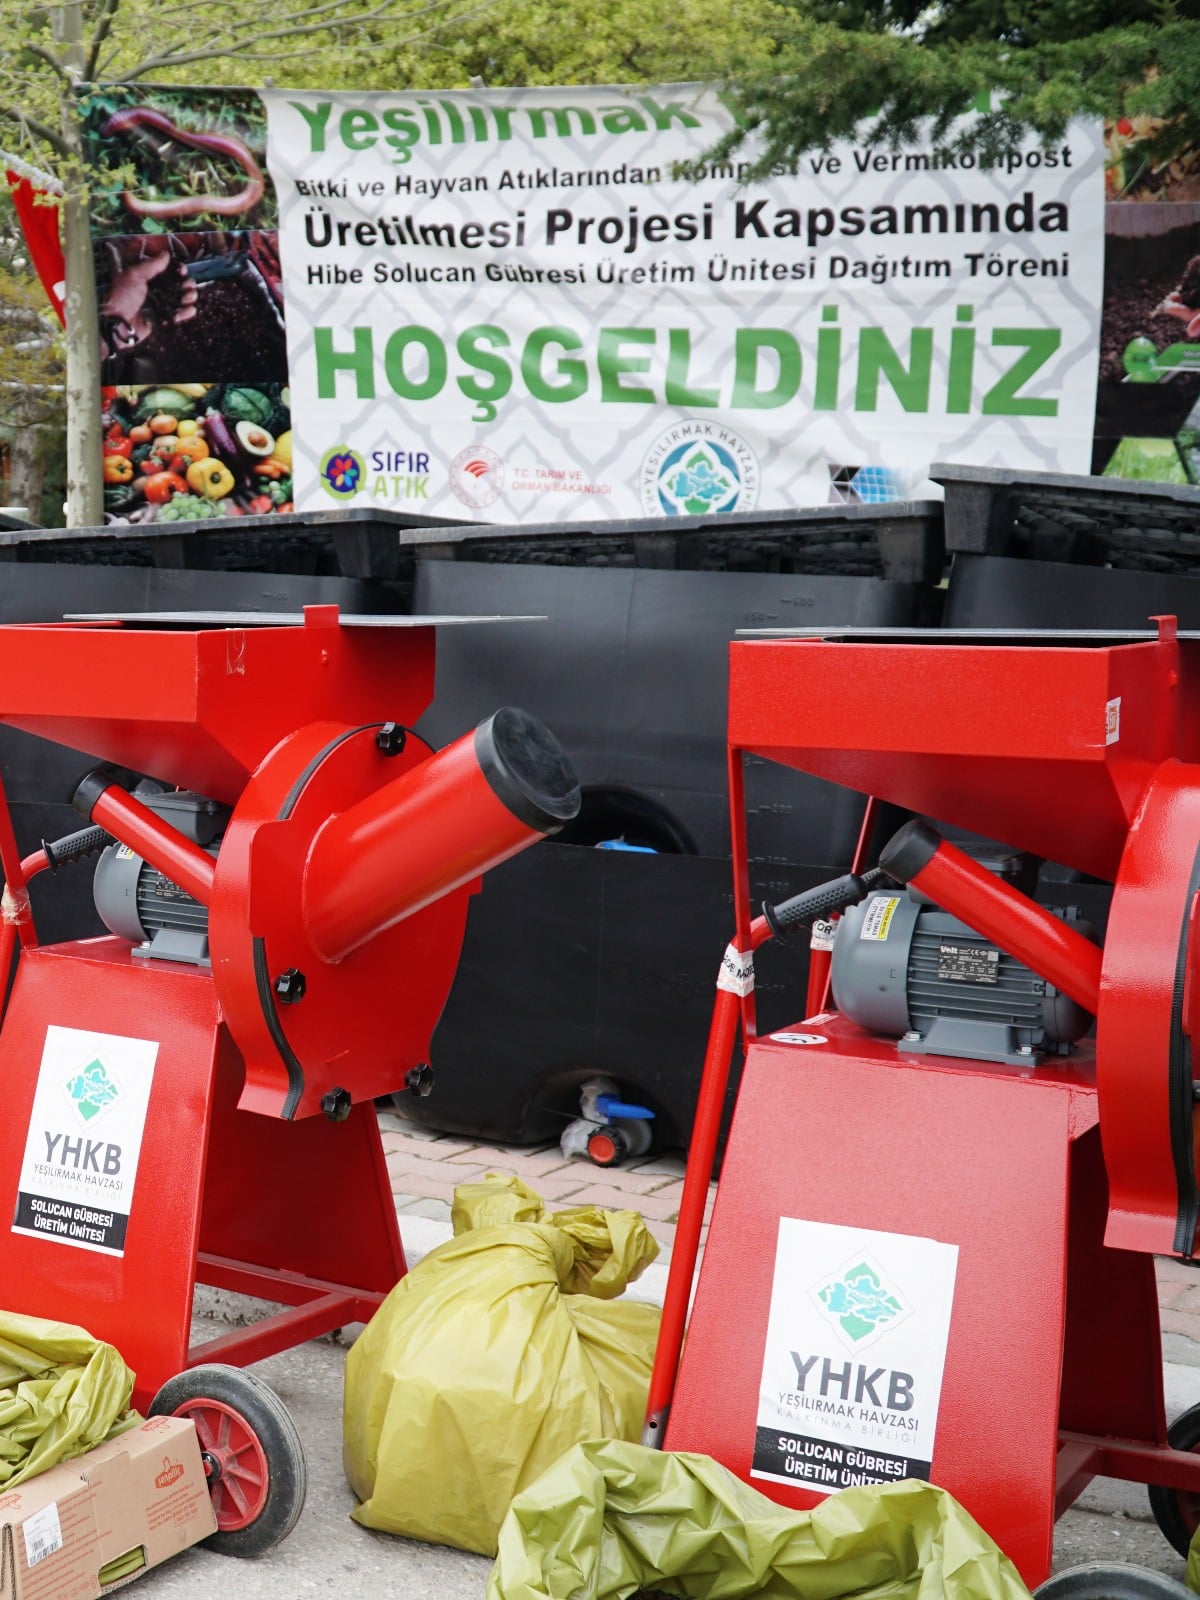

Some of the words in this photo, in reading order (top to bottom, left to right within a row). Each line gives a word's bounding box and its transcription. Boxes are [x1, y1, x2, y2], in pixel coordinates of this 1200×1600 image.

[287, 97, 702, 164] Yeşilırmak
[295, 178, 347, 198] Bitki
[358, 181, 385, 197] ve
[395, 173, 488, 199] Hayvan
[498, 164, 661, 190] Atıklarından
[810, 156, 842, 175] ve
[304, 206, 526, 248] Üretilmesi
[545, 202, 713, 254] Projesi
[734, 191, 1069, 246] Kapsamında
[307, 263, 363, 285] Hibe
[374, 262, 475, 284] Solucan
[485, 262, 586, 284] Gübresi
[597, 257, 695, 284] Üretim
[708, 254, 816, 282] Ünitesi
[829, 253, 951, 284] Dağıtım
[964, 252, 1069, 278] Töreni
[314, 304, 1062, 422] HOŞGELDİNİZ
[372, 451, 430, 474] SIFIR
[372, 475, 430, 499] ATIK
[44, 1131, 122, 1176] YHKB
[85, 1174, 123, 1191] HAVZASI
[30, 1199, 72, 1219] SOLUCAN
[73, 1208, 114, 1228] GÜBRESİ
[33, 1214, 68, 1234] ÜRETİM
[69, 1222, 106, 1243] ÜNİTESİ
[790, 1351, 915, 1412] YHKB
[860, 1408, 919, 1431] HAVZASI
[778, 1437, 843, 1464] SOLUCAN
[846, 1449, 908, 1477] GÜBRESİ
[785, 1456, 838, 1483] ÜRETİM
